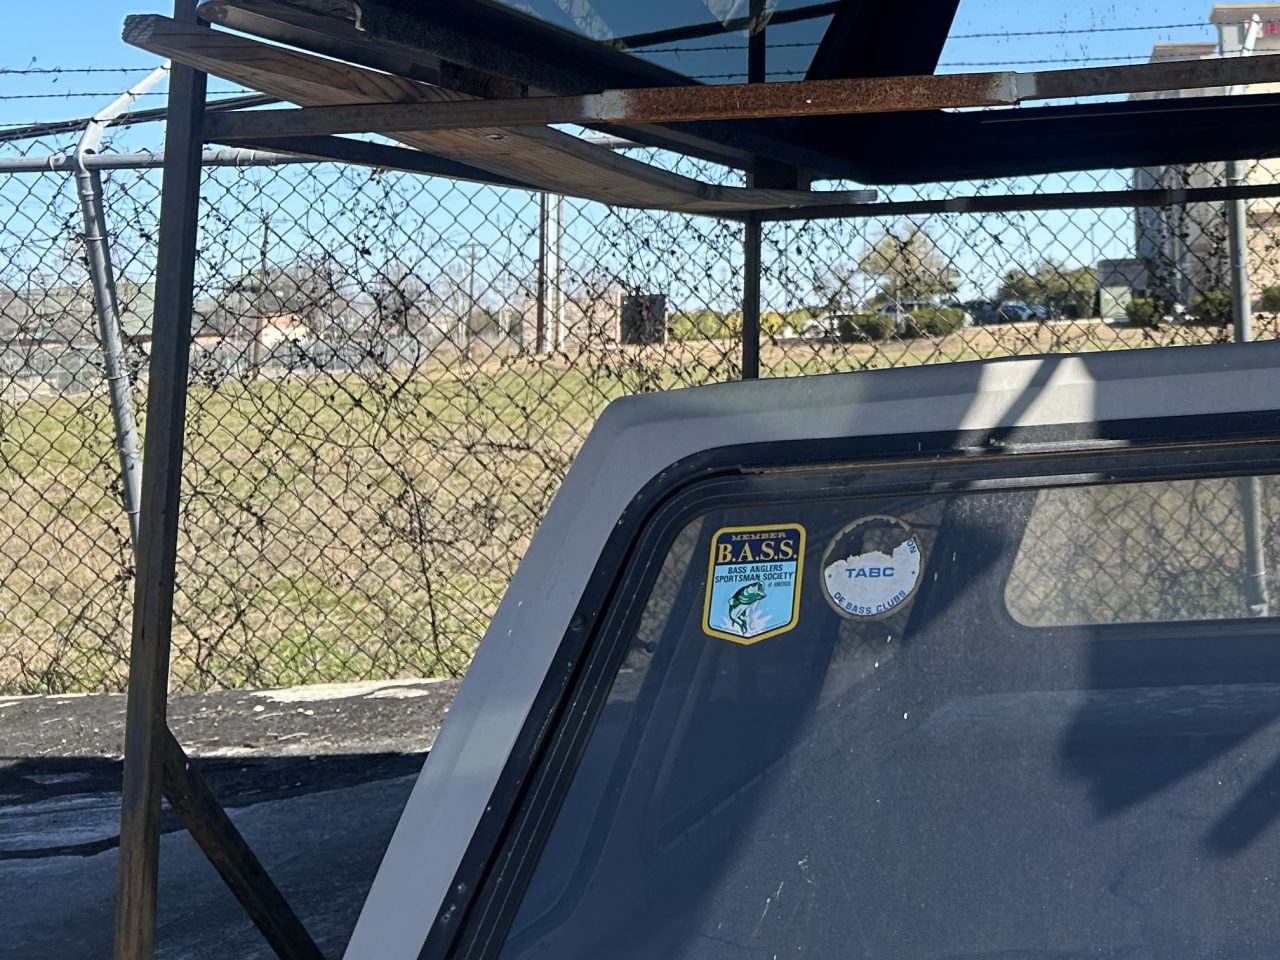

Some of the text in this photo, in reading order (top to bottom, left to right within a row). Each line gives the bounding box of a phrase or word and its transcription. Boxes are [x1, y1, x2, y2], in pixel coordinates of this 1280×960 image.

[731, 532, 786, 542] MEMBER
[717, 540, 797, 563] B.A.S.S.
[728, 564, 783, 575] BASS ANGLERS
[845, 567, 894, 578] TABC
[715, 572, 794, 583] SPORTSMAN SOCIETY
[834, 590, 906, 615] OF BASS CLUBS
